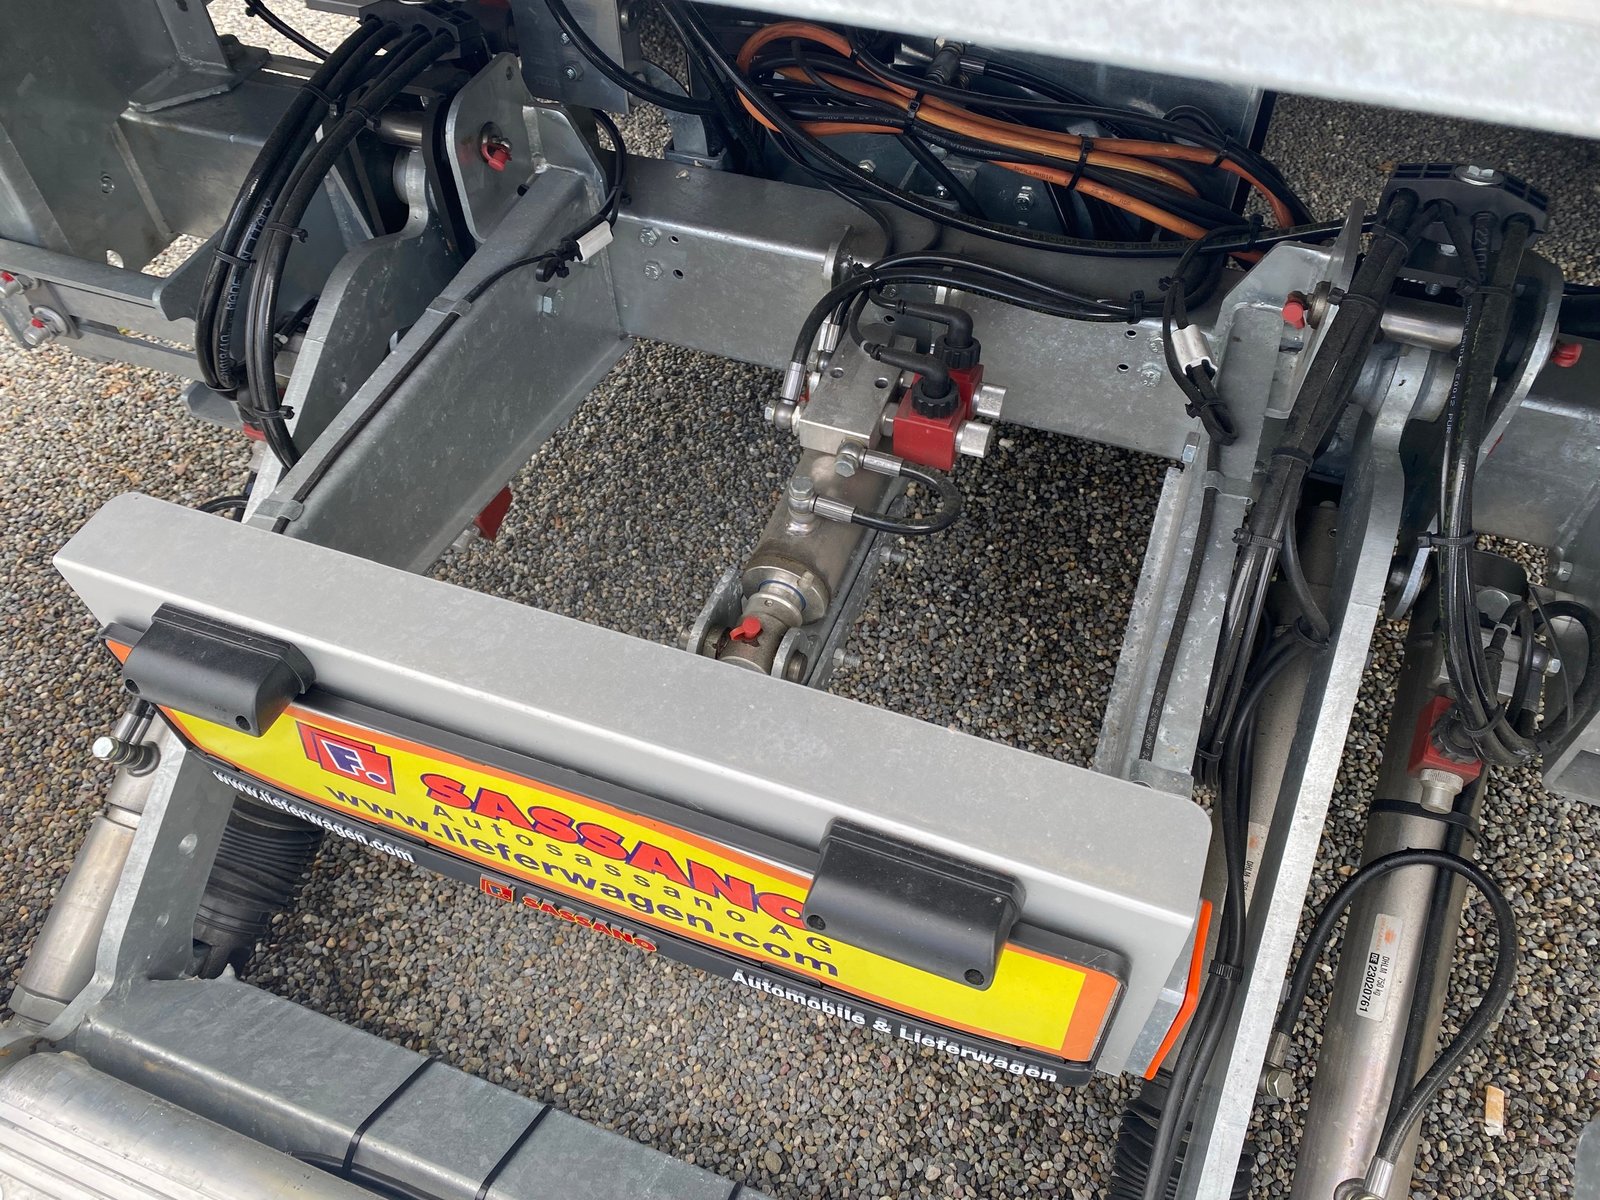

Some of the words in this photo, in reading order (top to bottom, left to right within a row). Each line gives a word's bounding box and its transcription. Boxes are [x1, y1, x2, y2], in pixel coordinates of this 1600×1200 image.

[212, 770, 415, 863] www.lieferwagen.com
[420, 773, 807, 931] SASSANO
[324, 785, 838, 977] www.lieferwagen.com
[433, 804, 746, 923] Autosassano
[769, 924, 832, 954] AG
[521, 894, 657, 952] SASSANO
[1359, 965, 1377, 1013] 23020761
[1380, 955, 1390, 974] DHLM
[732, 970, 865, 1025] Automobile
[873, 1019, 891, 1034] &
[900, 1026, 1057, 1083] Lieferwagen
